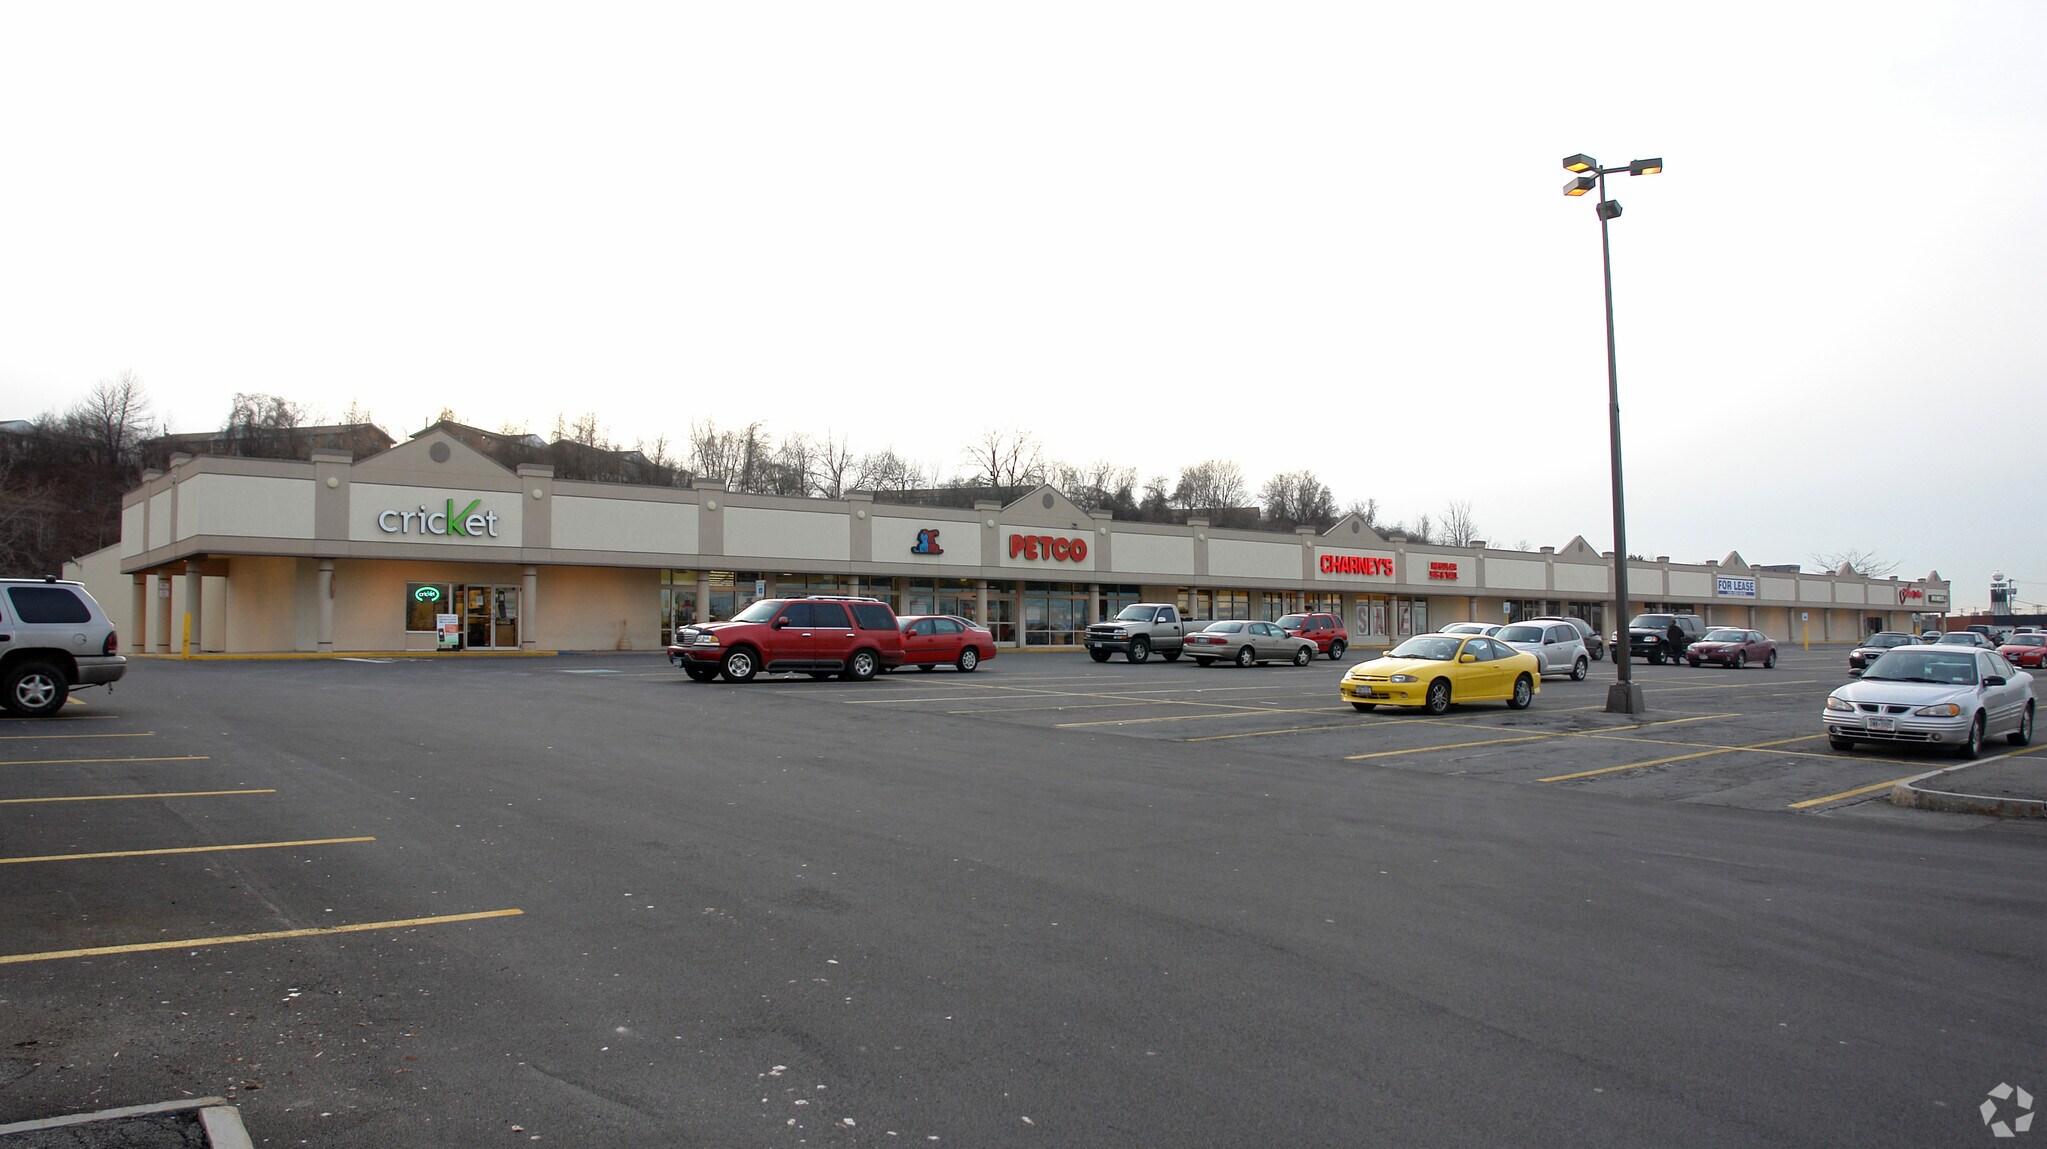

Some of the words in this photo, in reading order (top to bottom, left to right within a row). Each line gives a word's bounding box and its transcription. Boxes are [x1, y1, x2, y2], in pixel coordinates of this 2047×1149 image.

[378, 498, 499, 538] cricket
[1009, 534, 1088, 563] PETCO
[1320, 554, 1394, 576] CHARNEY'S
[1718, 580, 1732, 590] FOR
[1733, 581, 1754, 592] LEASE
